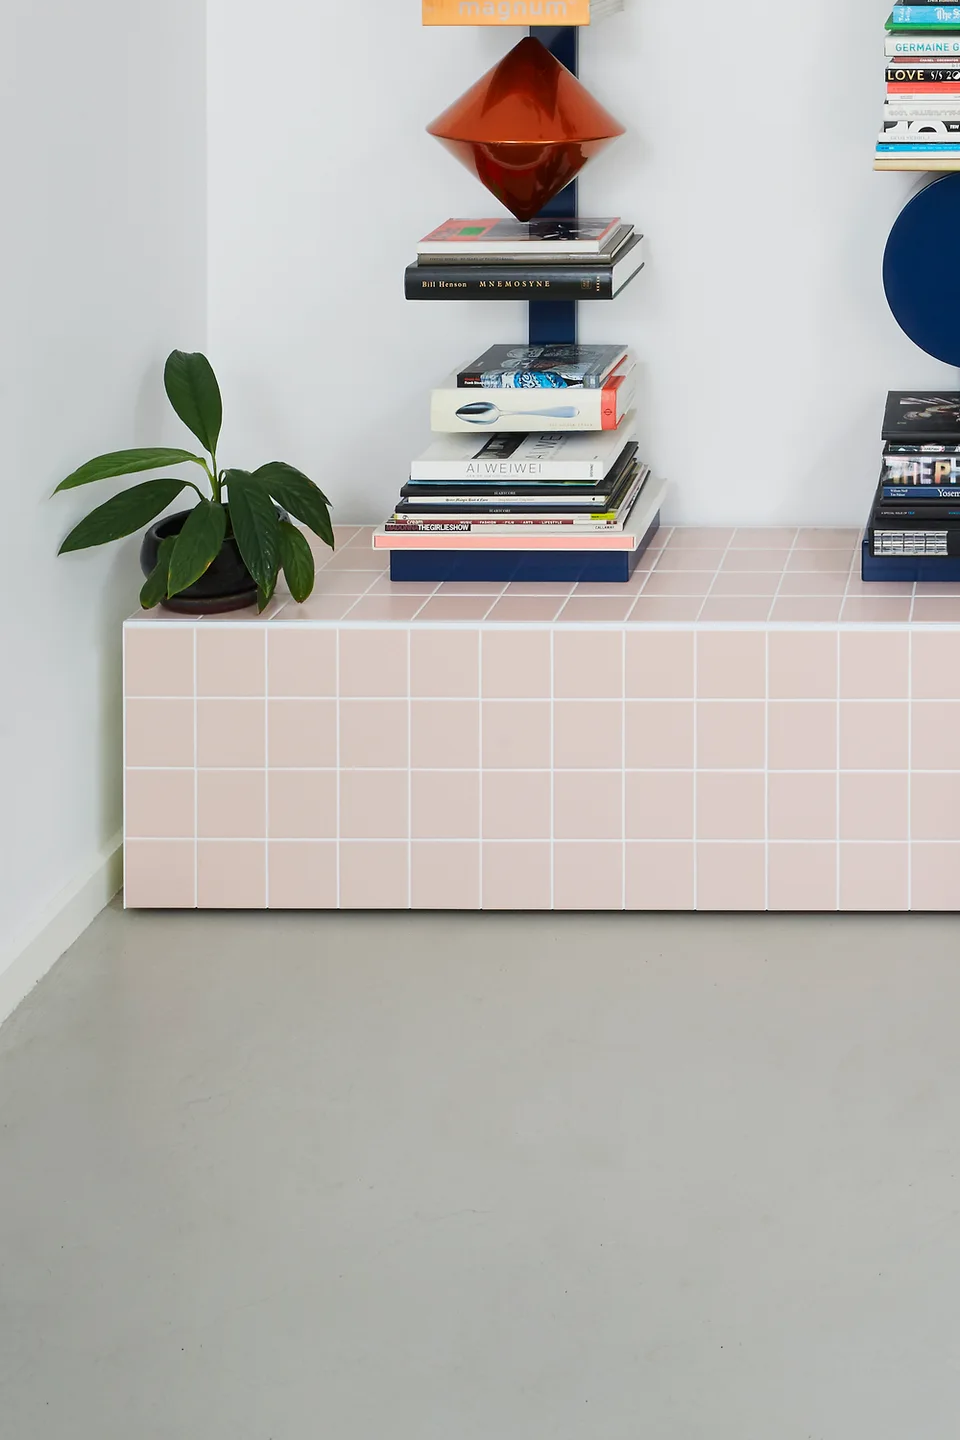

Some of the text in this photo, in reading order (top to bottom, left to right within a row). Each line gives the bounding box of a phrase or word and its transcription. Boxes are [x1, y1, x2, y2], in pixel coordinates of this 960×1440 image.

[934, 7, 952, 21] The
[895, 43, 950, 51] GERMAINE
[888, 70, 924, 80] LOVE
[930, 70, 943, 79] S/S
[466, 464, 541, 473] AI WEIWEI
